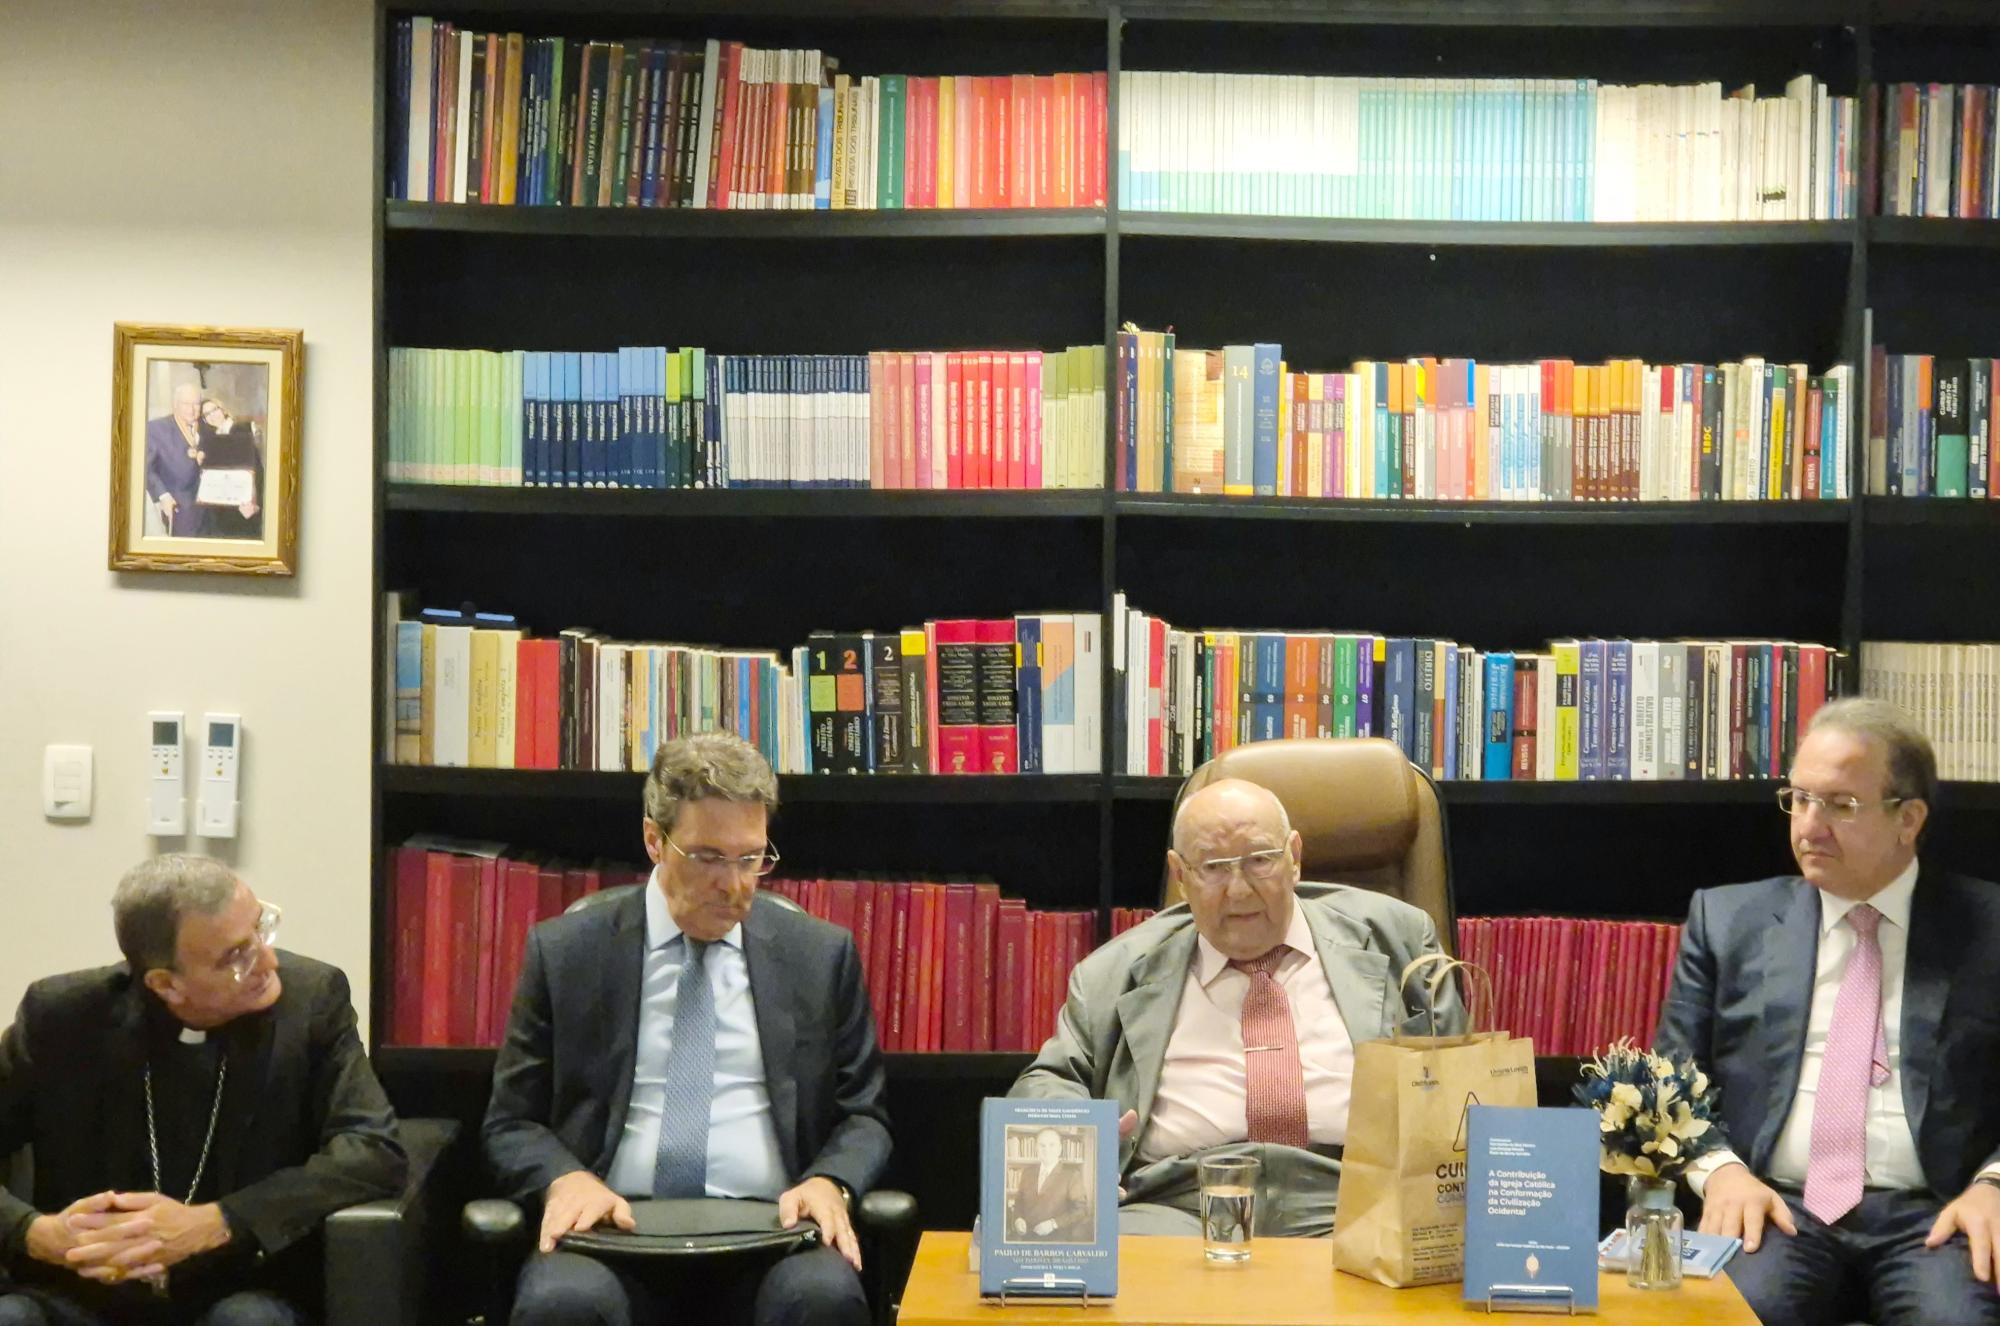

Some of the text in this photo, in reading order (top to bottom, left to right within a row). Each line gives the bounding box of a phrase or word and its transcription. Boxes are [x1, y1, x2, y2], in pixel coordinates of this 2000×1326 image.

[1232, 365, 1248, 380] 14
[1940, 380, 1946, 390] DE
[817, 650, 826, 670] 1
[844, 650, 857, 670] 2
[884, 646, 893, 661] 2
[1664, 656, 1671, 669] 2
[1424, 651, 1432, 691] DIREITO
[1362, 694, 1368, 703] 07
[1663, 697, 1671, 728] DIREITO
[1645, 695, 1654, 762] ADMINISTRATIVO
[1436, 1162, 1464, 1179] CUI
[1496, 1170, 1546, 1180] Contribuição
[1437, 1184, 1464, 1194] CONT
[1500, 1180, 1523, 1189] Igreja
[1524, 1180, 1556, 1188] Católica
[1500, 1189, 1552, 1199] Conformação
[1500, 1198, 1540, 1208] Civilização
